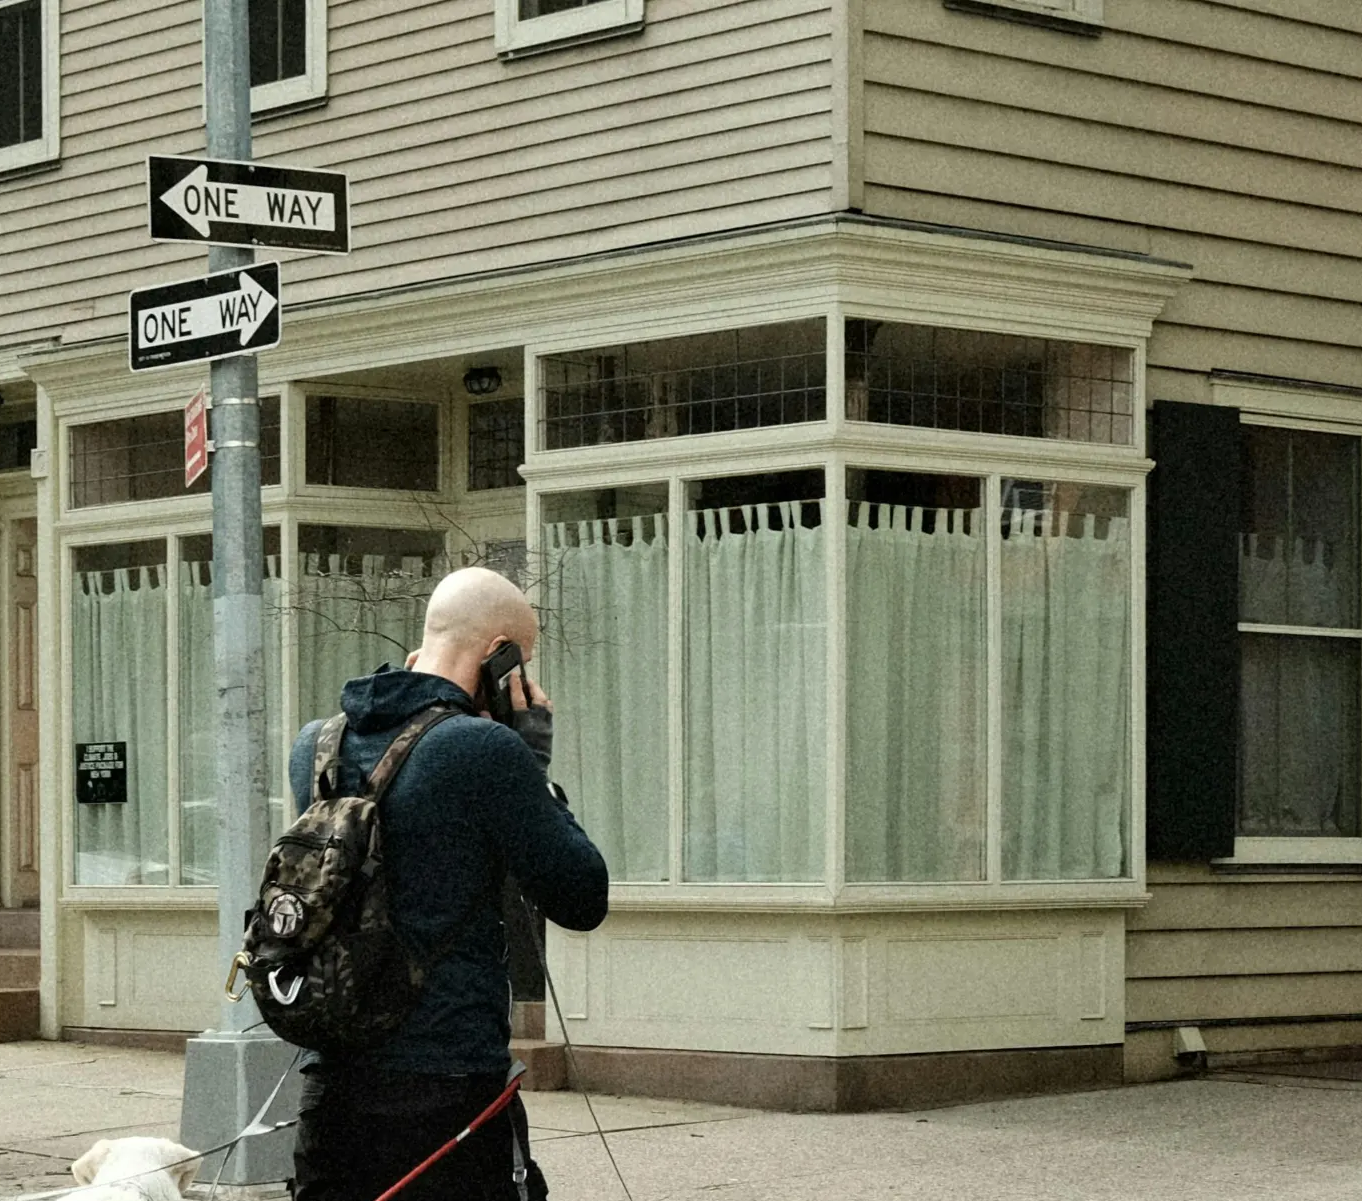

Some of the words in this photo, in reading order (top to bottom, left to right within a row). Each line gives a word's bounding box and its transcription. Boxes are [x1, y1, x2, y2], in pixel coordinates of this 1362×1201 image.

[184, 184, 239, 219] ONE
[266, 191, 323, 226] WAY
[144, 306, 192, 343] ONE
[219, 290, 263, 329] WAY
